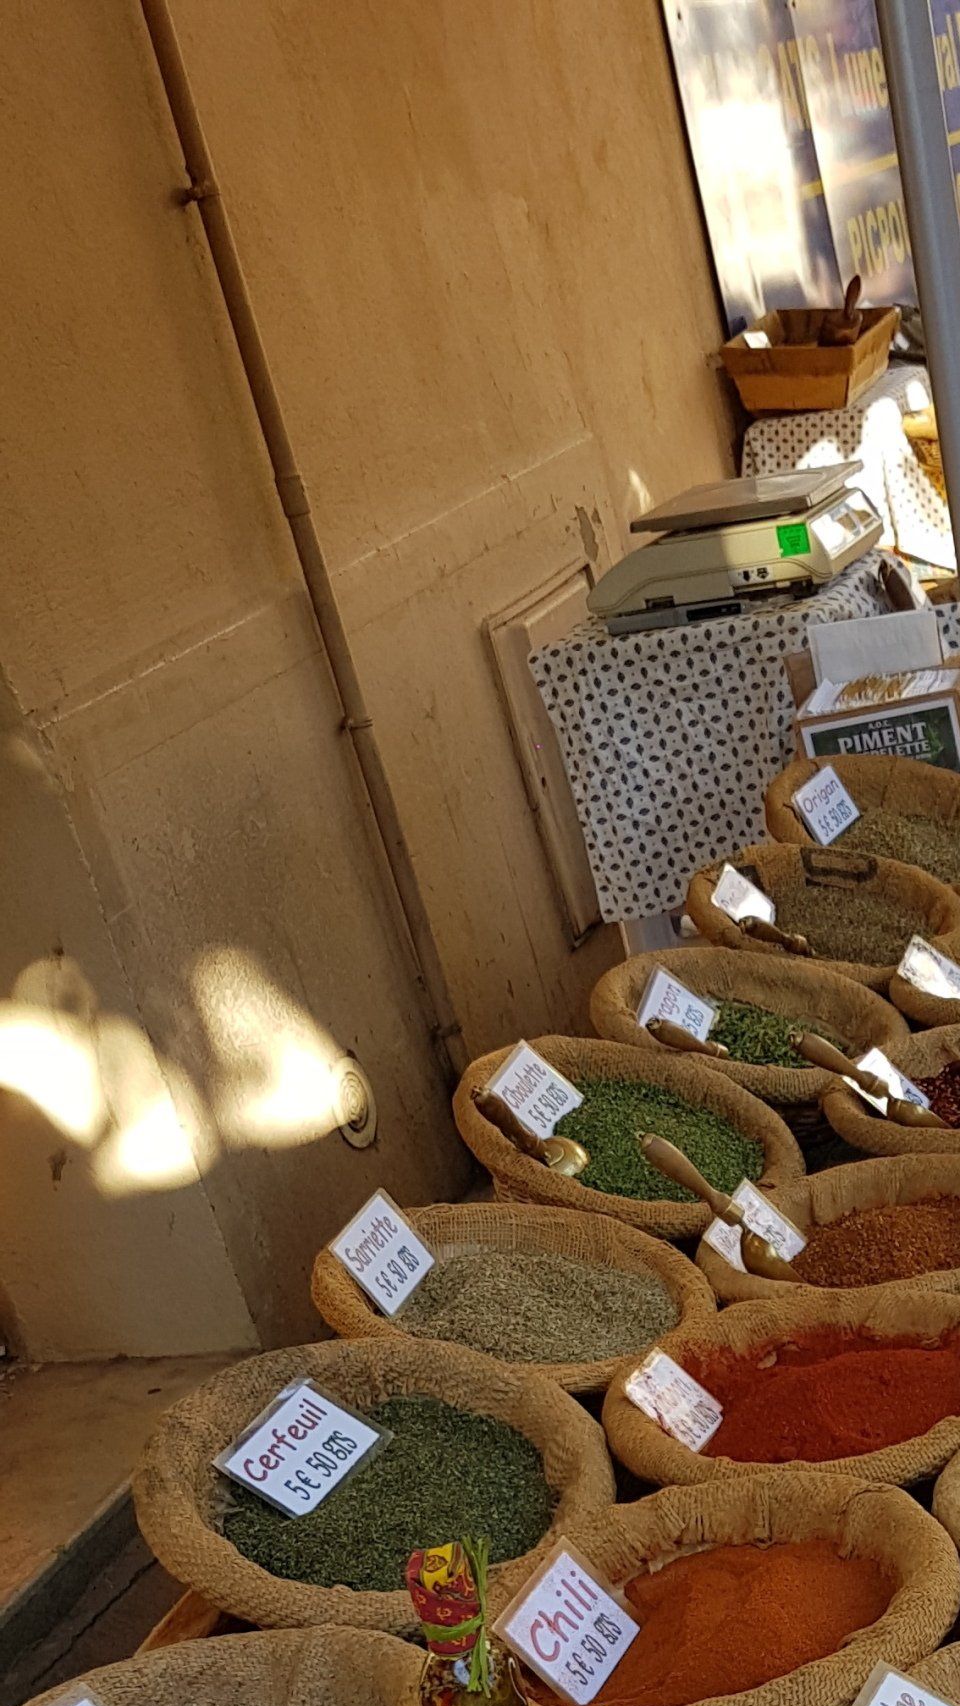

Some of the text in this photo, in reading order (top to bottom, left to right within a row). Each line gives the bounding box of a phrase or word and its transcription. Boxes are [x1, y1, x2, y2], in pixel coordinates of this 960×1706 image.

[826, 32, 890, 116] Lune
[837, 721, 926, 755] PIMENT
[803, 780, 839, 813] Origan
[654, 983, 682, 1018] ragon
[502, 1063, 547, 1109] Ciboulette
[528, 1104, 551, 1128] 5€
[345, 1216, 398, 1272] Sarriette
[375, 1270, 398, 1298] 5€
[387, 1260, 408, 1284] 50
[243, 1398, 328, 1482] Cerfeuil
[284, 1469, 321, 1501] 5€
[305, 1451, 338, 1478] 50
[530, 1570, 598, 1662] Chili
[565, 1652, 595, 1686] 5€
[581, 1634, 607, 1663] 50
